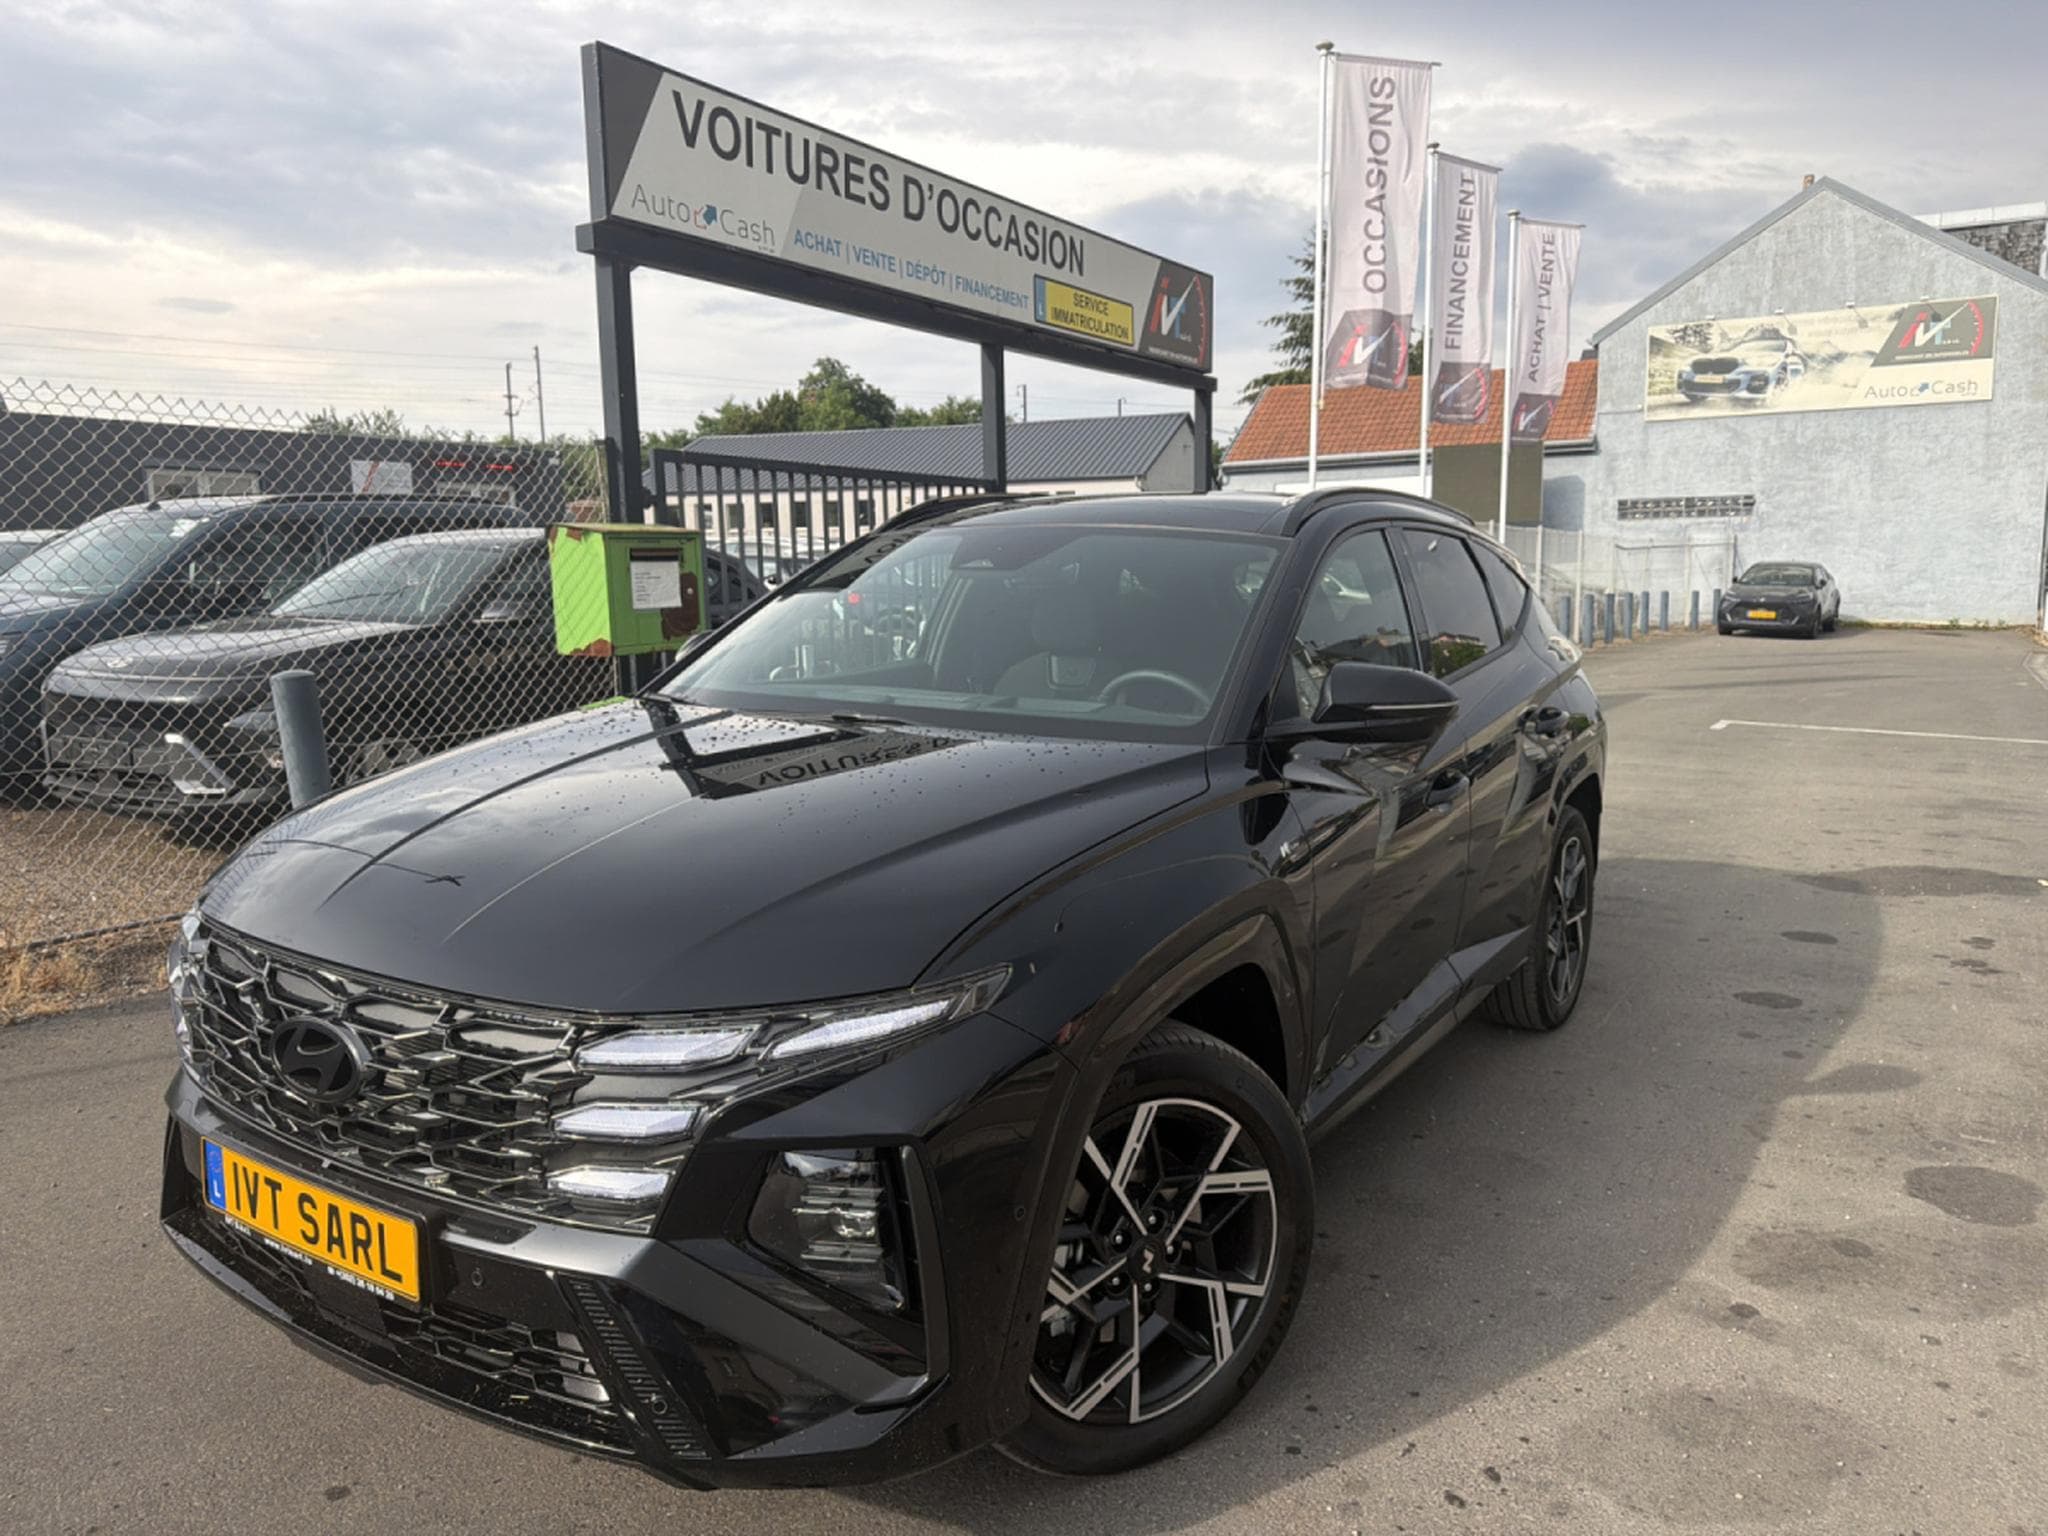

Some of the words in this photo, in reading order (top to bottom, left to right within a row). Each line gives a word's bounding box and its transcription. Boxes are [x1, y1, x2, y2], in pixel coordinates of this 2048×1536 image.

[631, 183, 690, 223] Auto
[719, 208, 775, 246] Cash
[671, 89, 890, 212] VOITURES
[903, 173, 1084, 277] D'OCCASION
[1362, 76, 1396, 294] OCCASIONS
[794, 229, 841, 258] ACHAT
[852, 244, 897, 273] VENTE
[906, 260, 945, 287] DÉPÔT
[955, 275, 1029, 309] FINANCEMENT
[1072, 292, 1109, 316] SERVICE
[1444, 173, 1475, 350] FINANCEMENT
[1528, 315, 1546, 382] ACHAT
[1537, 233, 1555, 299] VENTE
[1931, 379, 1978, 395] Cash
[212, 1179, 221, 1199] L
[232, 1161, 283, 1231] IVT
[297, 1191, 403, 1284] SARL
